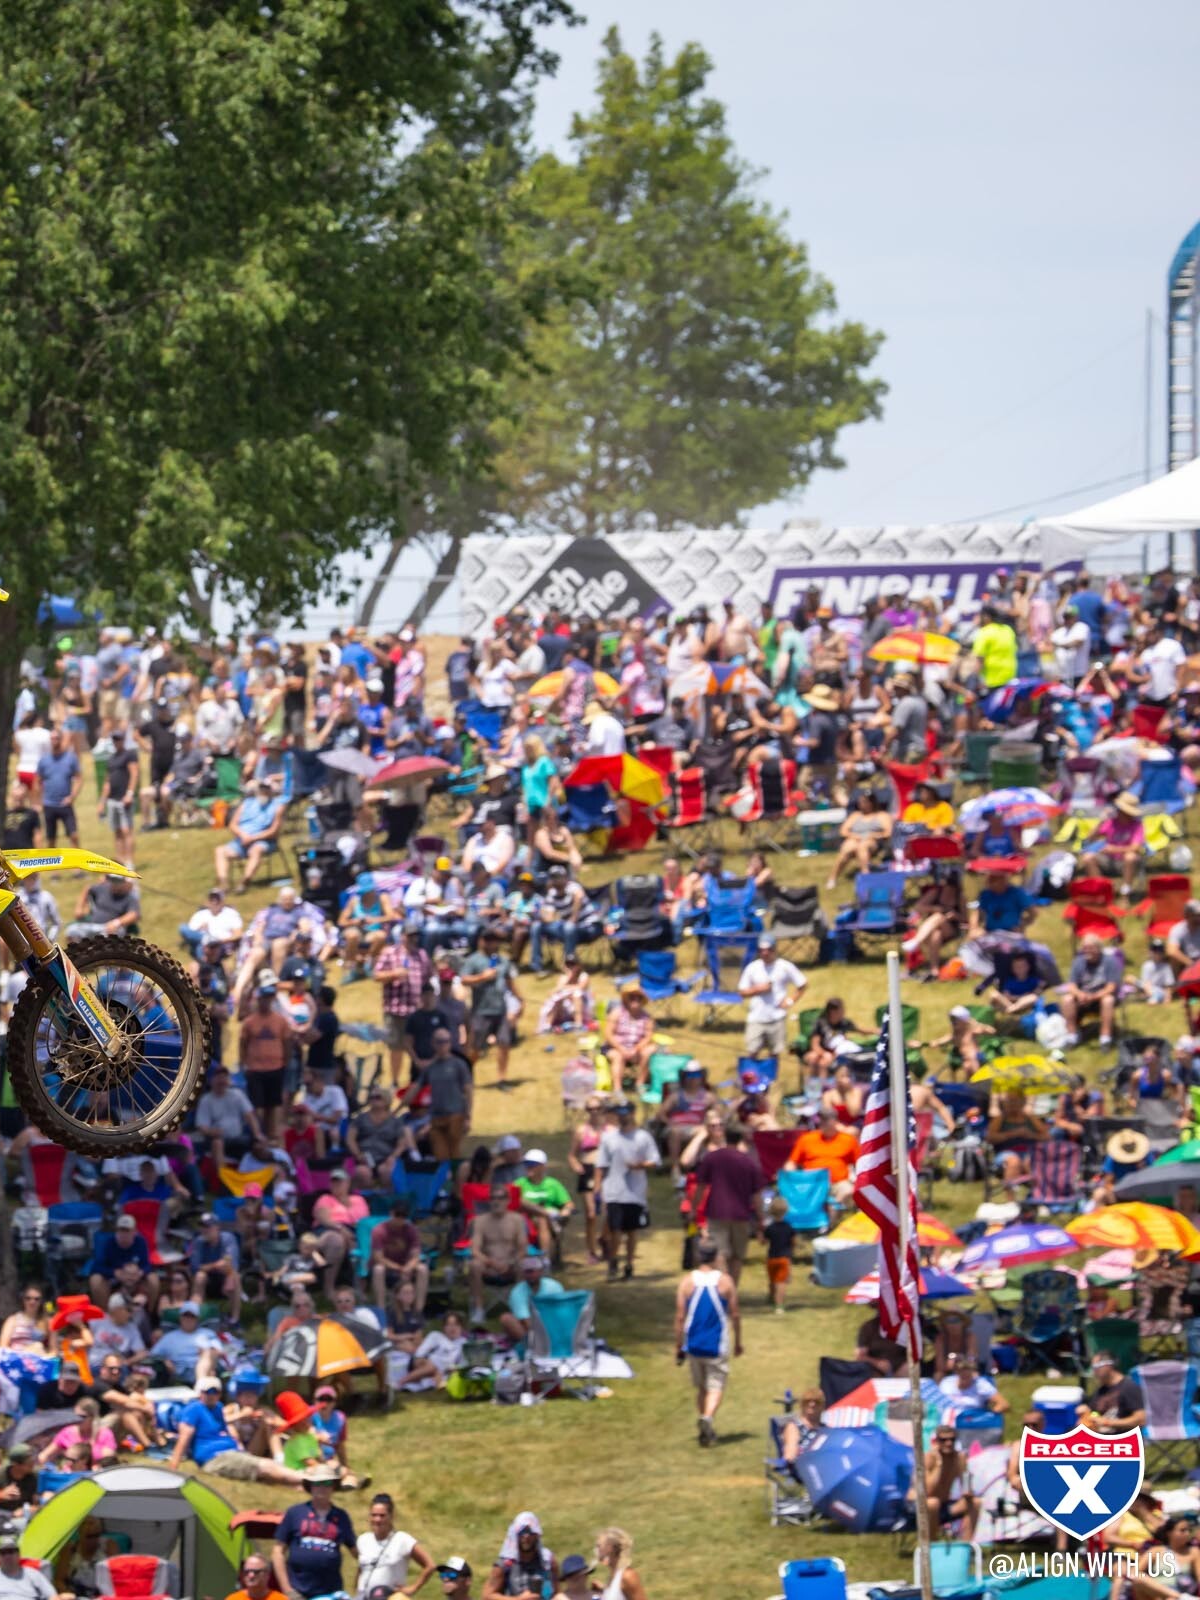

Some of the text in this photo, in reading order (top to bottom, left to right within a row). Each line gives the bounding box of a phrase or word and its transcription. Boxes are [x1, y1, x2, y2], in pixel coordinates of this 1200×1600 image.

[773, 572, 951, 616] FNISH
[19, 856, 62, 868] PROGRESSIVE
[78, 1000, 98, 1027] GALFER
